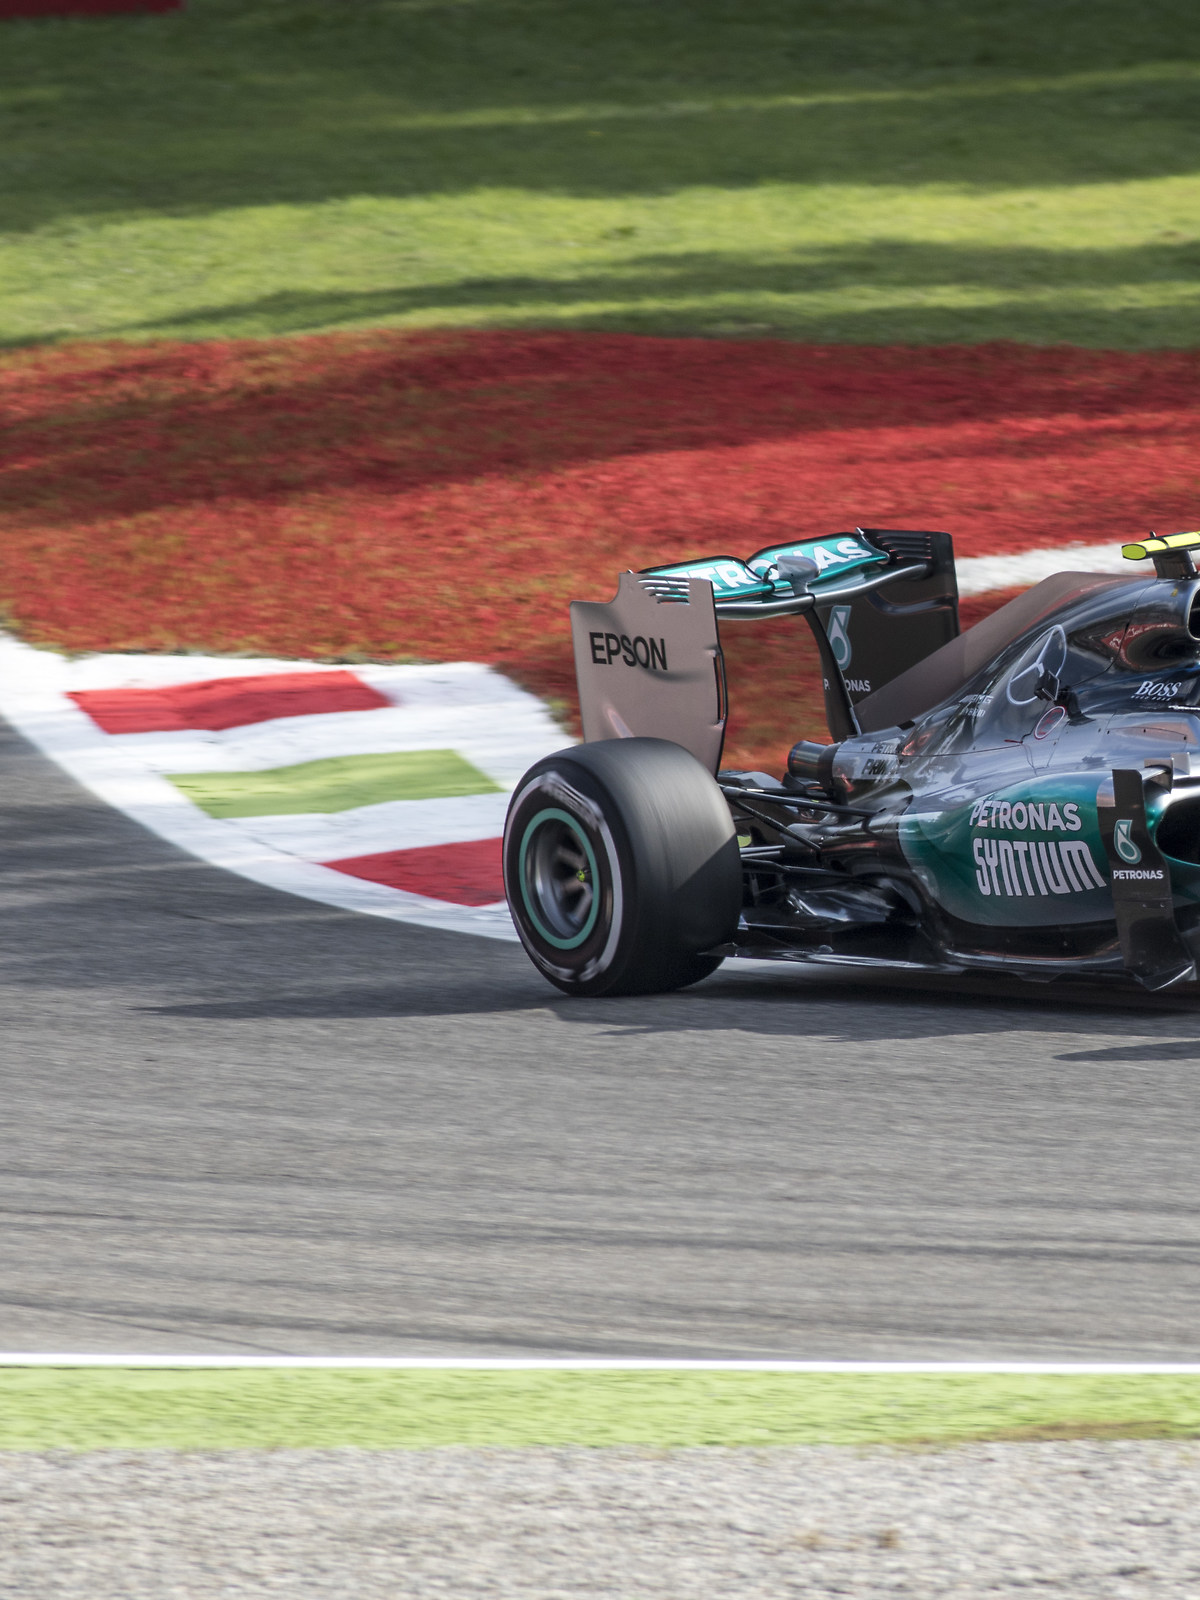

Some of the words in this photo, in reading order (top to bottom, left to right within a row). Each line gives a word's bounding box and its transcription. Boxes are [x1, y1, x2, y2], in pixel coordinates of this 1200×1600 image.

[664, 541, 873, 591] TROAS
[588, 631, 668, 671] EPSON
[823, 678, 872, 692] PONAS
[1135, 680, 1182, 697] BOSS
[969, 800, 1083, 832] PETRONAS
[972, 837, 1107, 897] SYNTIUM
[1112, 869, 1165, 880] PETRONAS
